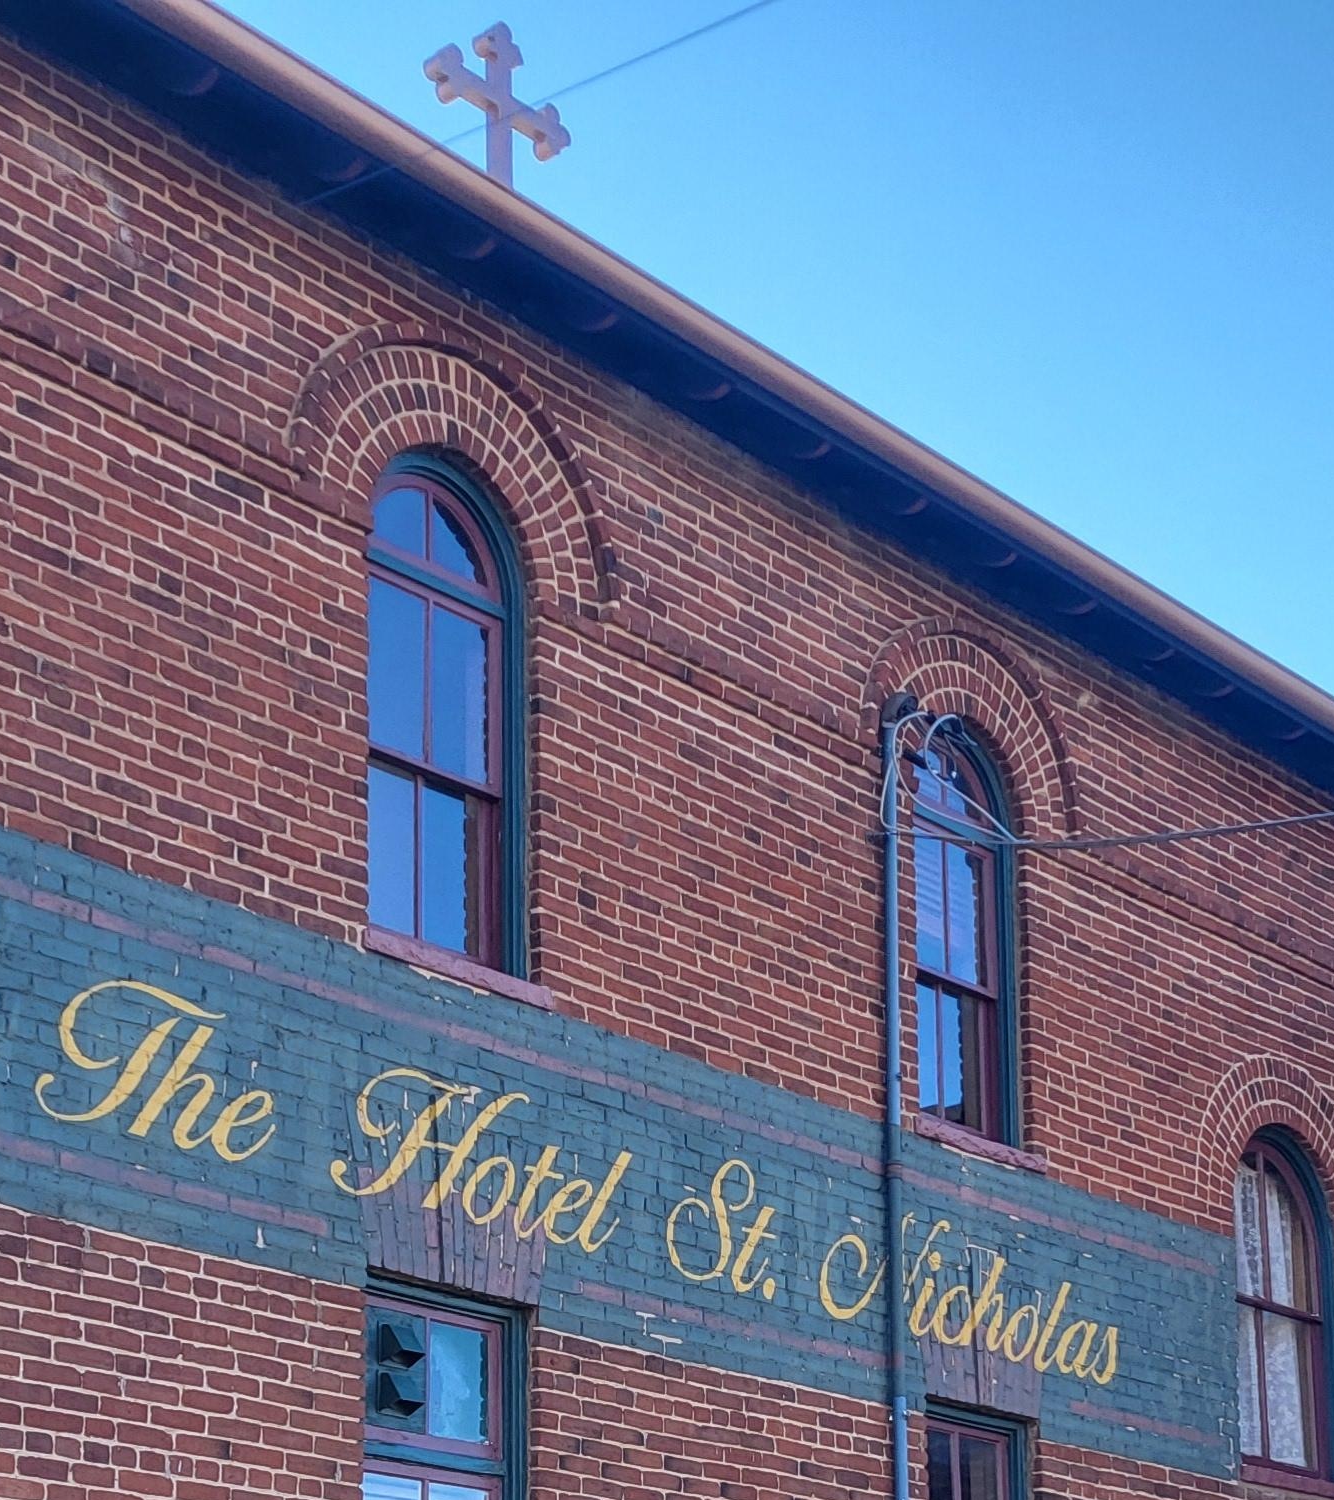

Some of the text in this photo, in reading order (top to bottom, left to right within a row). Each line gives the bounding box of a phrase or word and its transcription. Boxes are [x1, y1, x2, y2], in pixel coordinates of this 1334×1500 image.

[34, 979, 1119, 1385] The Hotel St. Nicholas
